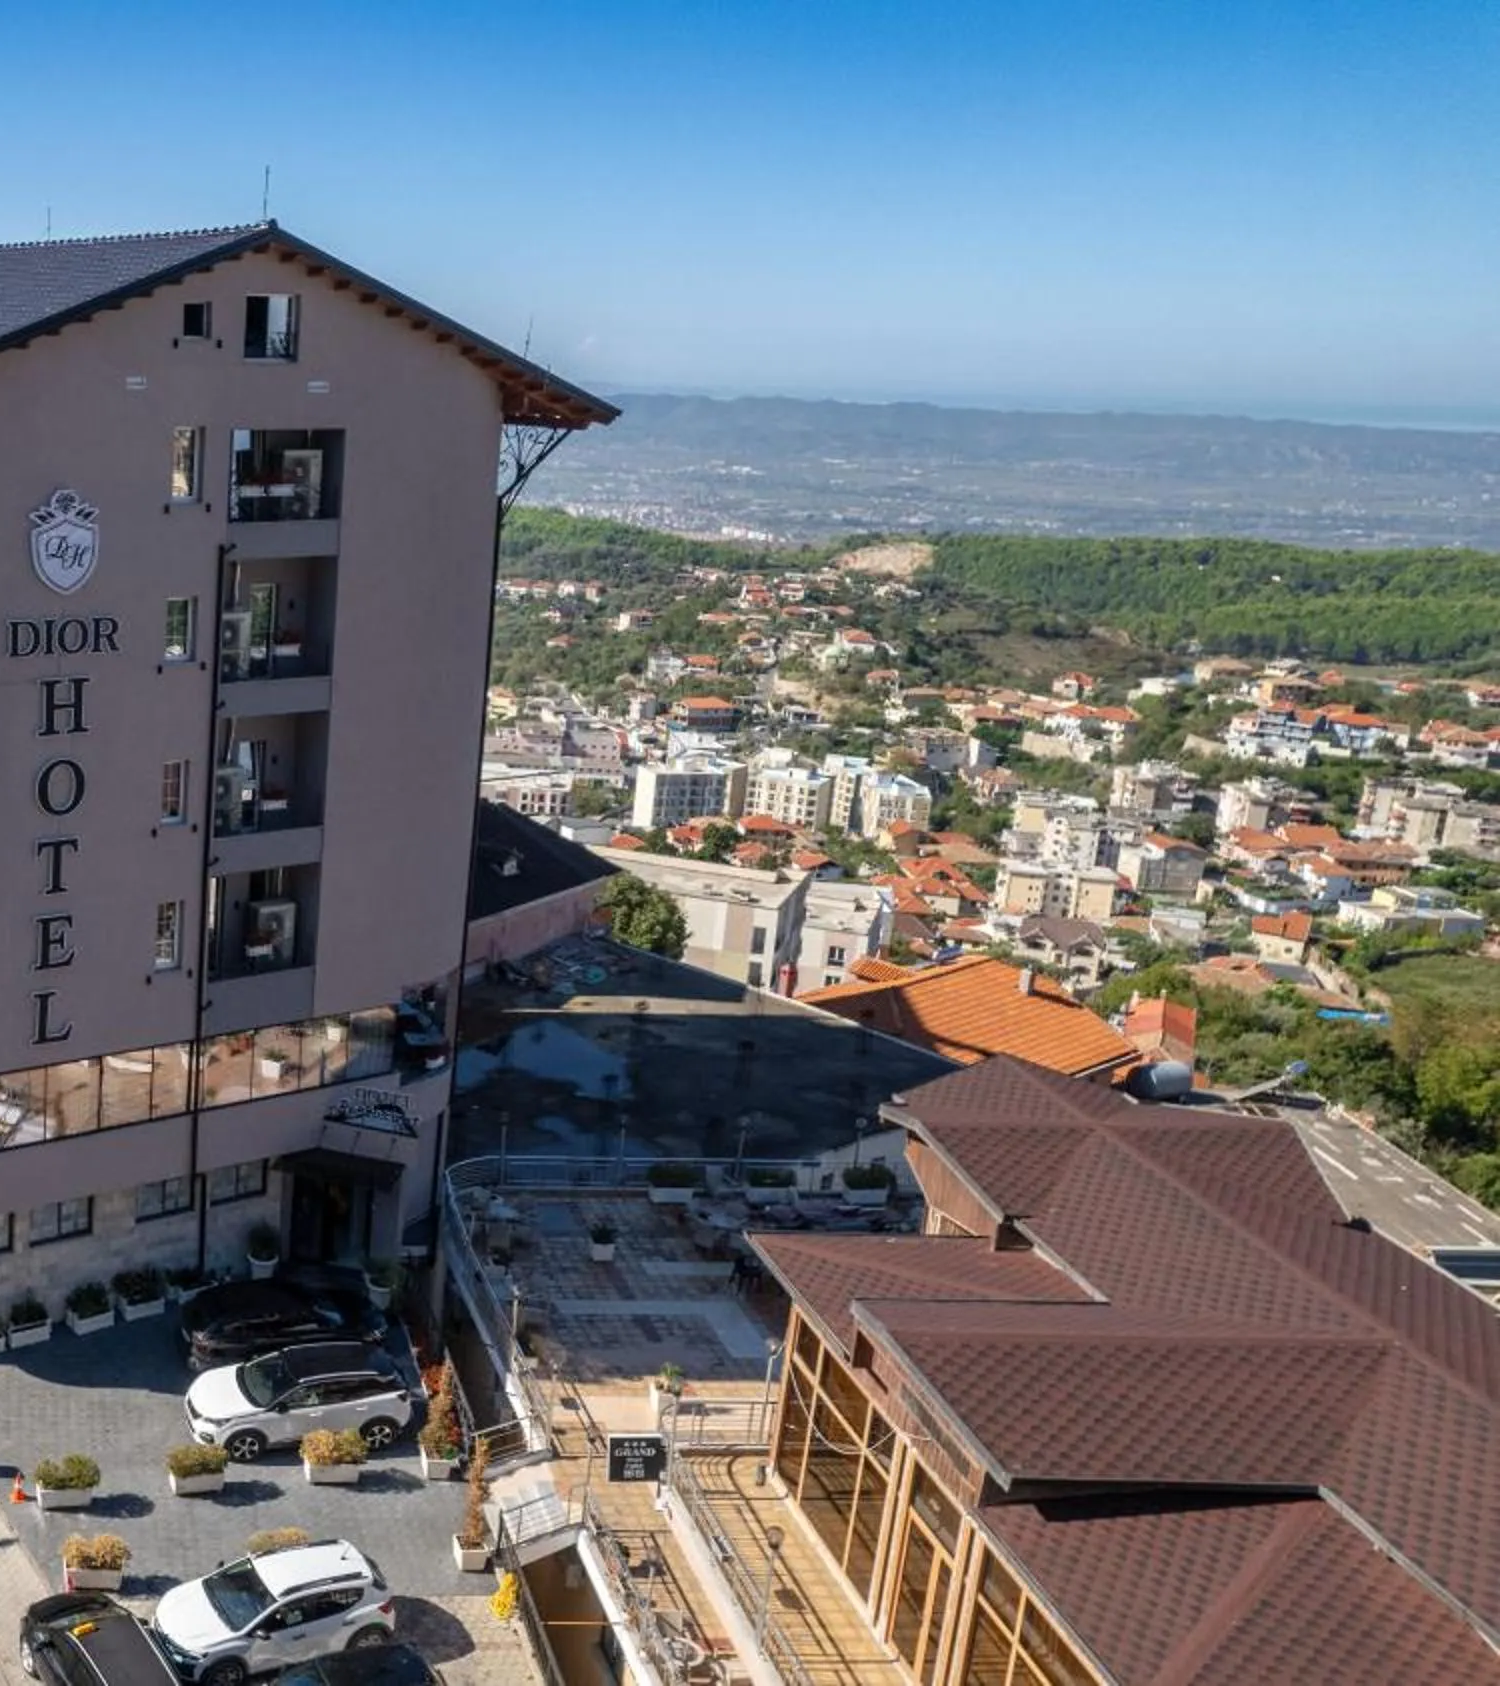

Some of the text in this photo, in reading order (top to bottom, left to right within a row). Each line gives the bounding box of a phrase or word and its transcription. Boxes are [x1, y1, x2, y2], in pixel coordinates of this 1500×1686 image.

[8, 616, 120, 658] DIOR
[32, 677, 91, 1045] HOTEL
[614, 1447, 657, 1457] GRAND
